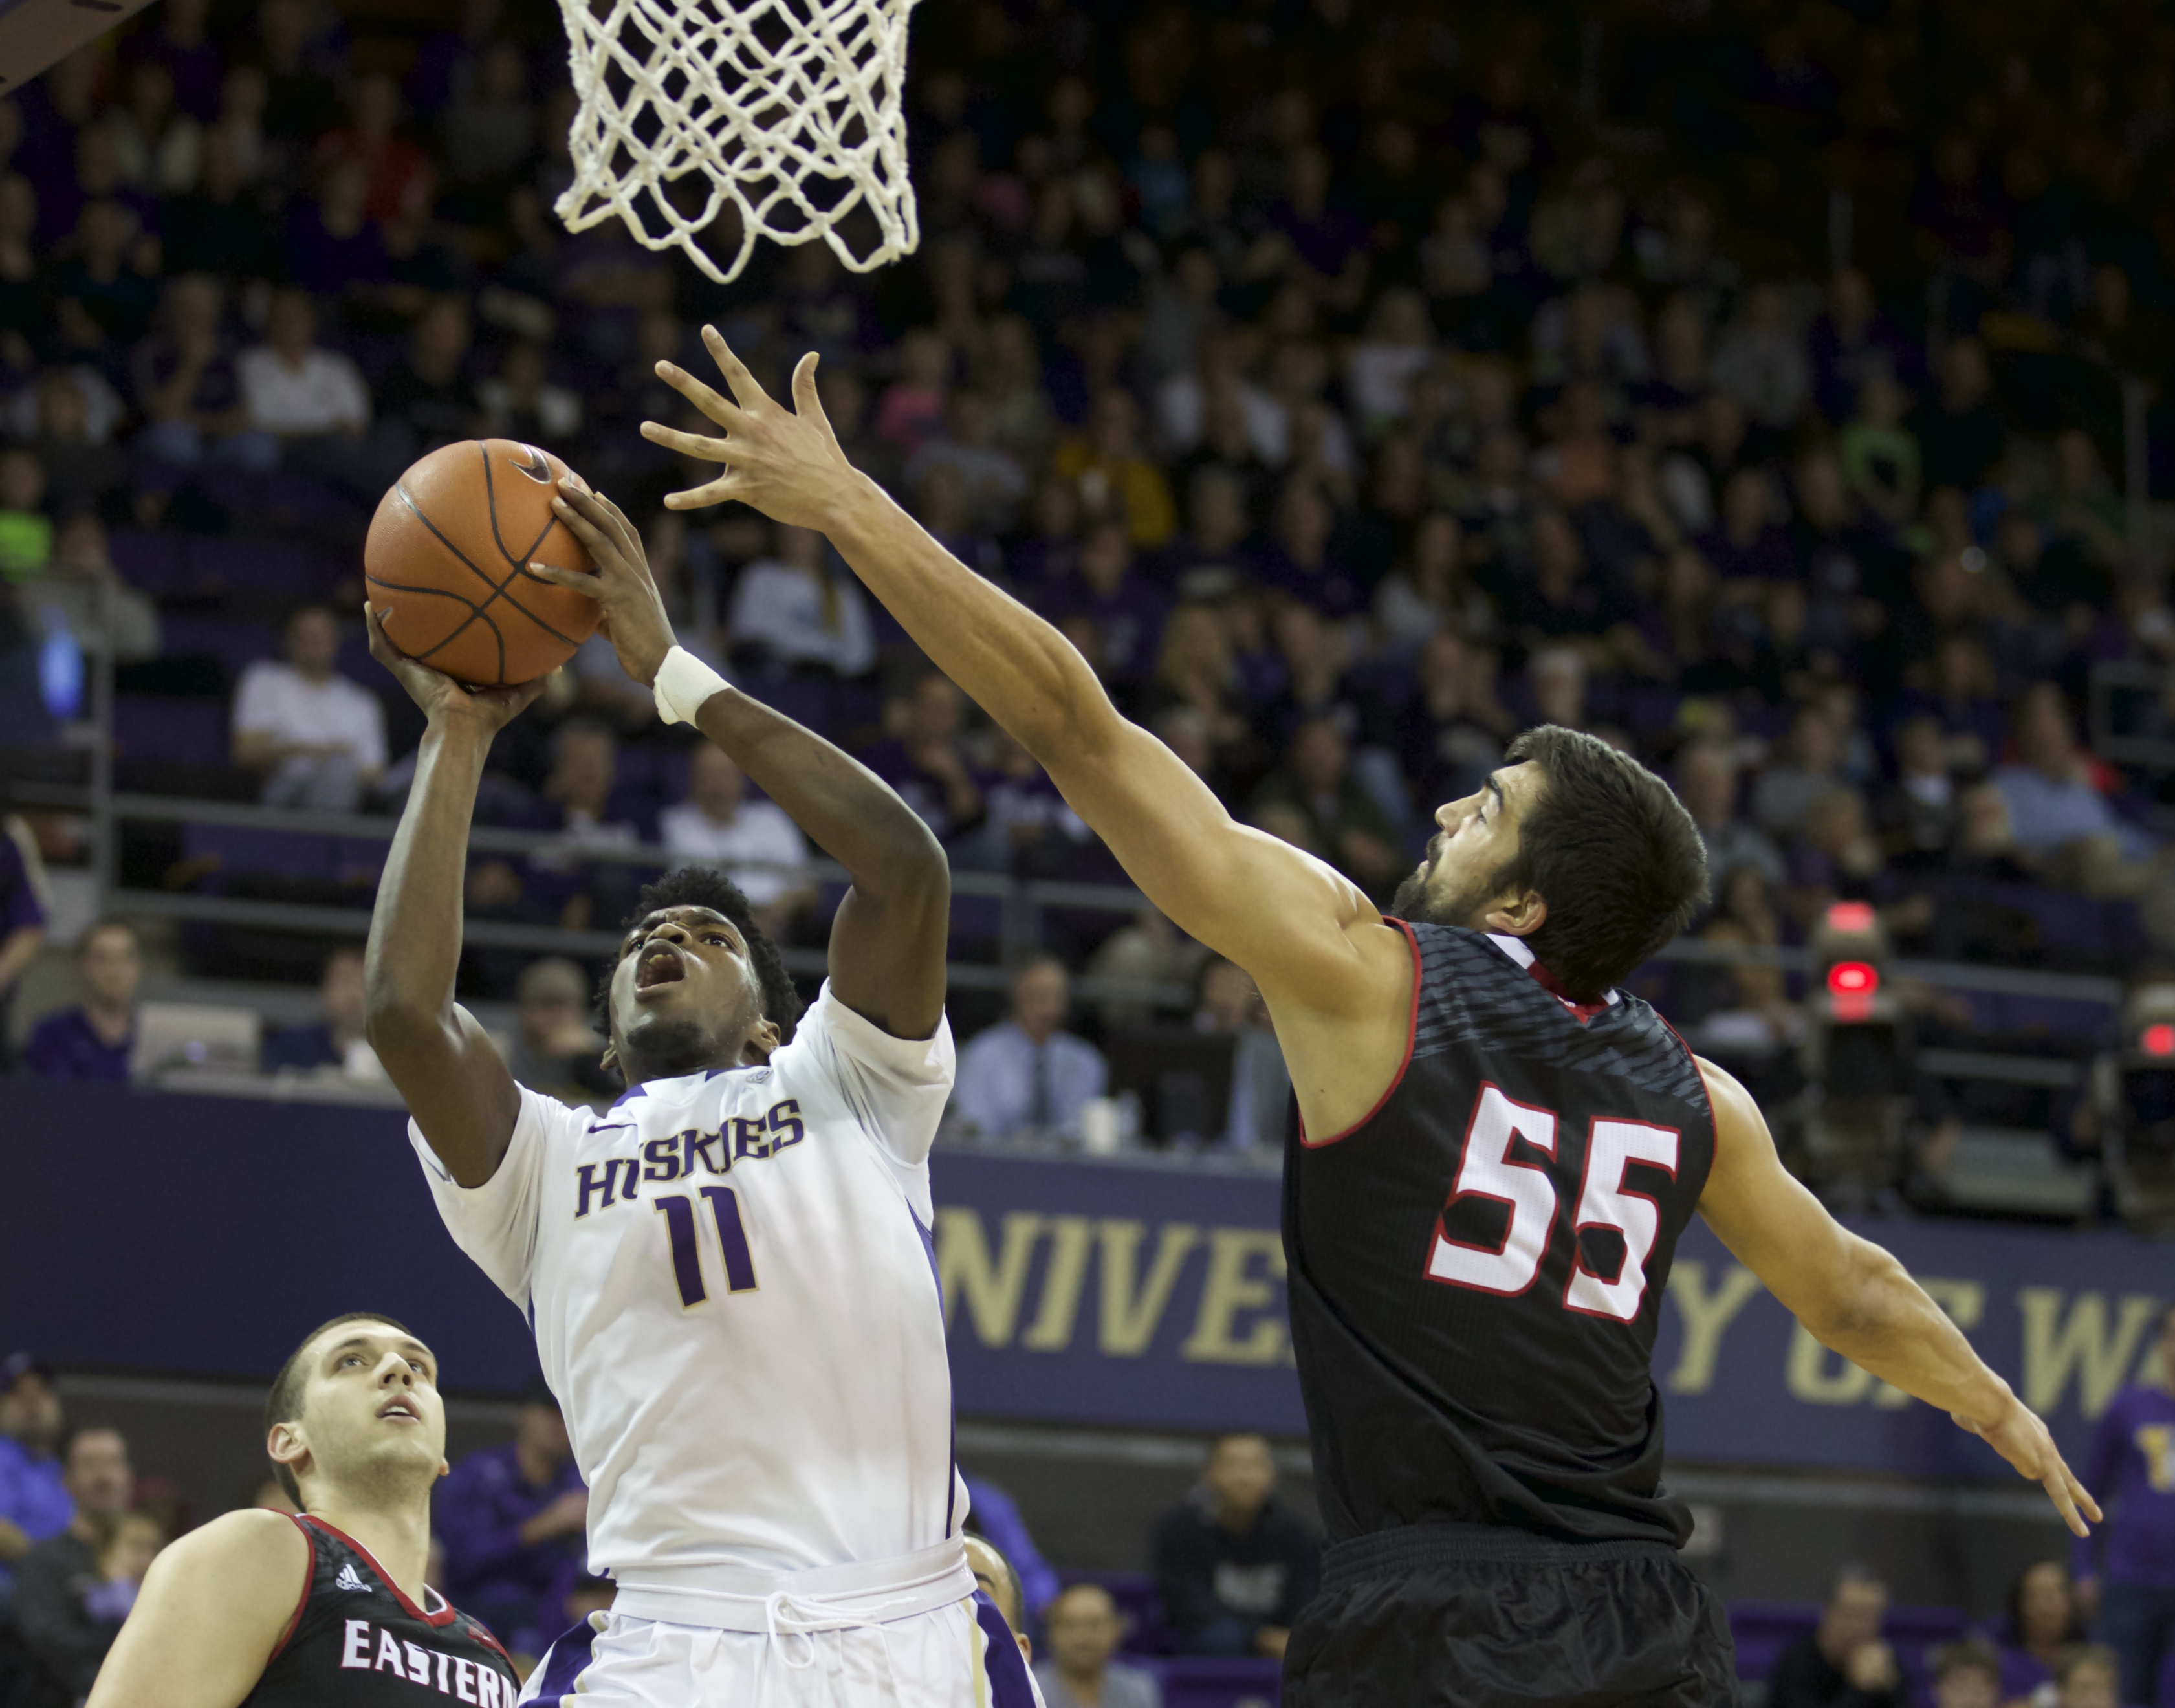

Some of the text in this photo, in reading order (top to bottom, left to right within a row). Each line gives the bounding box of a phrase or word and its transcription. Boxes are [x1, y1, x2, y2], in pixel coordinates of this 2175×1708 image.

[573, 1098, 806, 1221] HUSKIES
[1423, 1080, 1681, 1324] 55
[650, 1185, 760, 1311] 11
